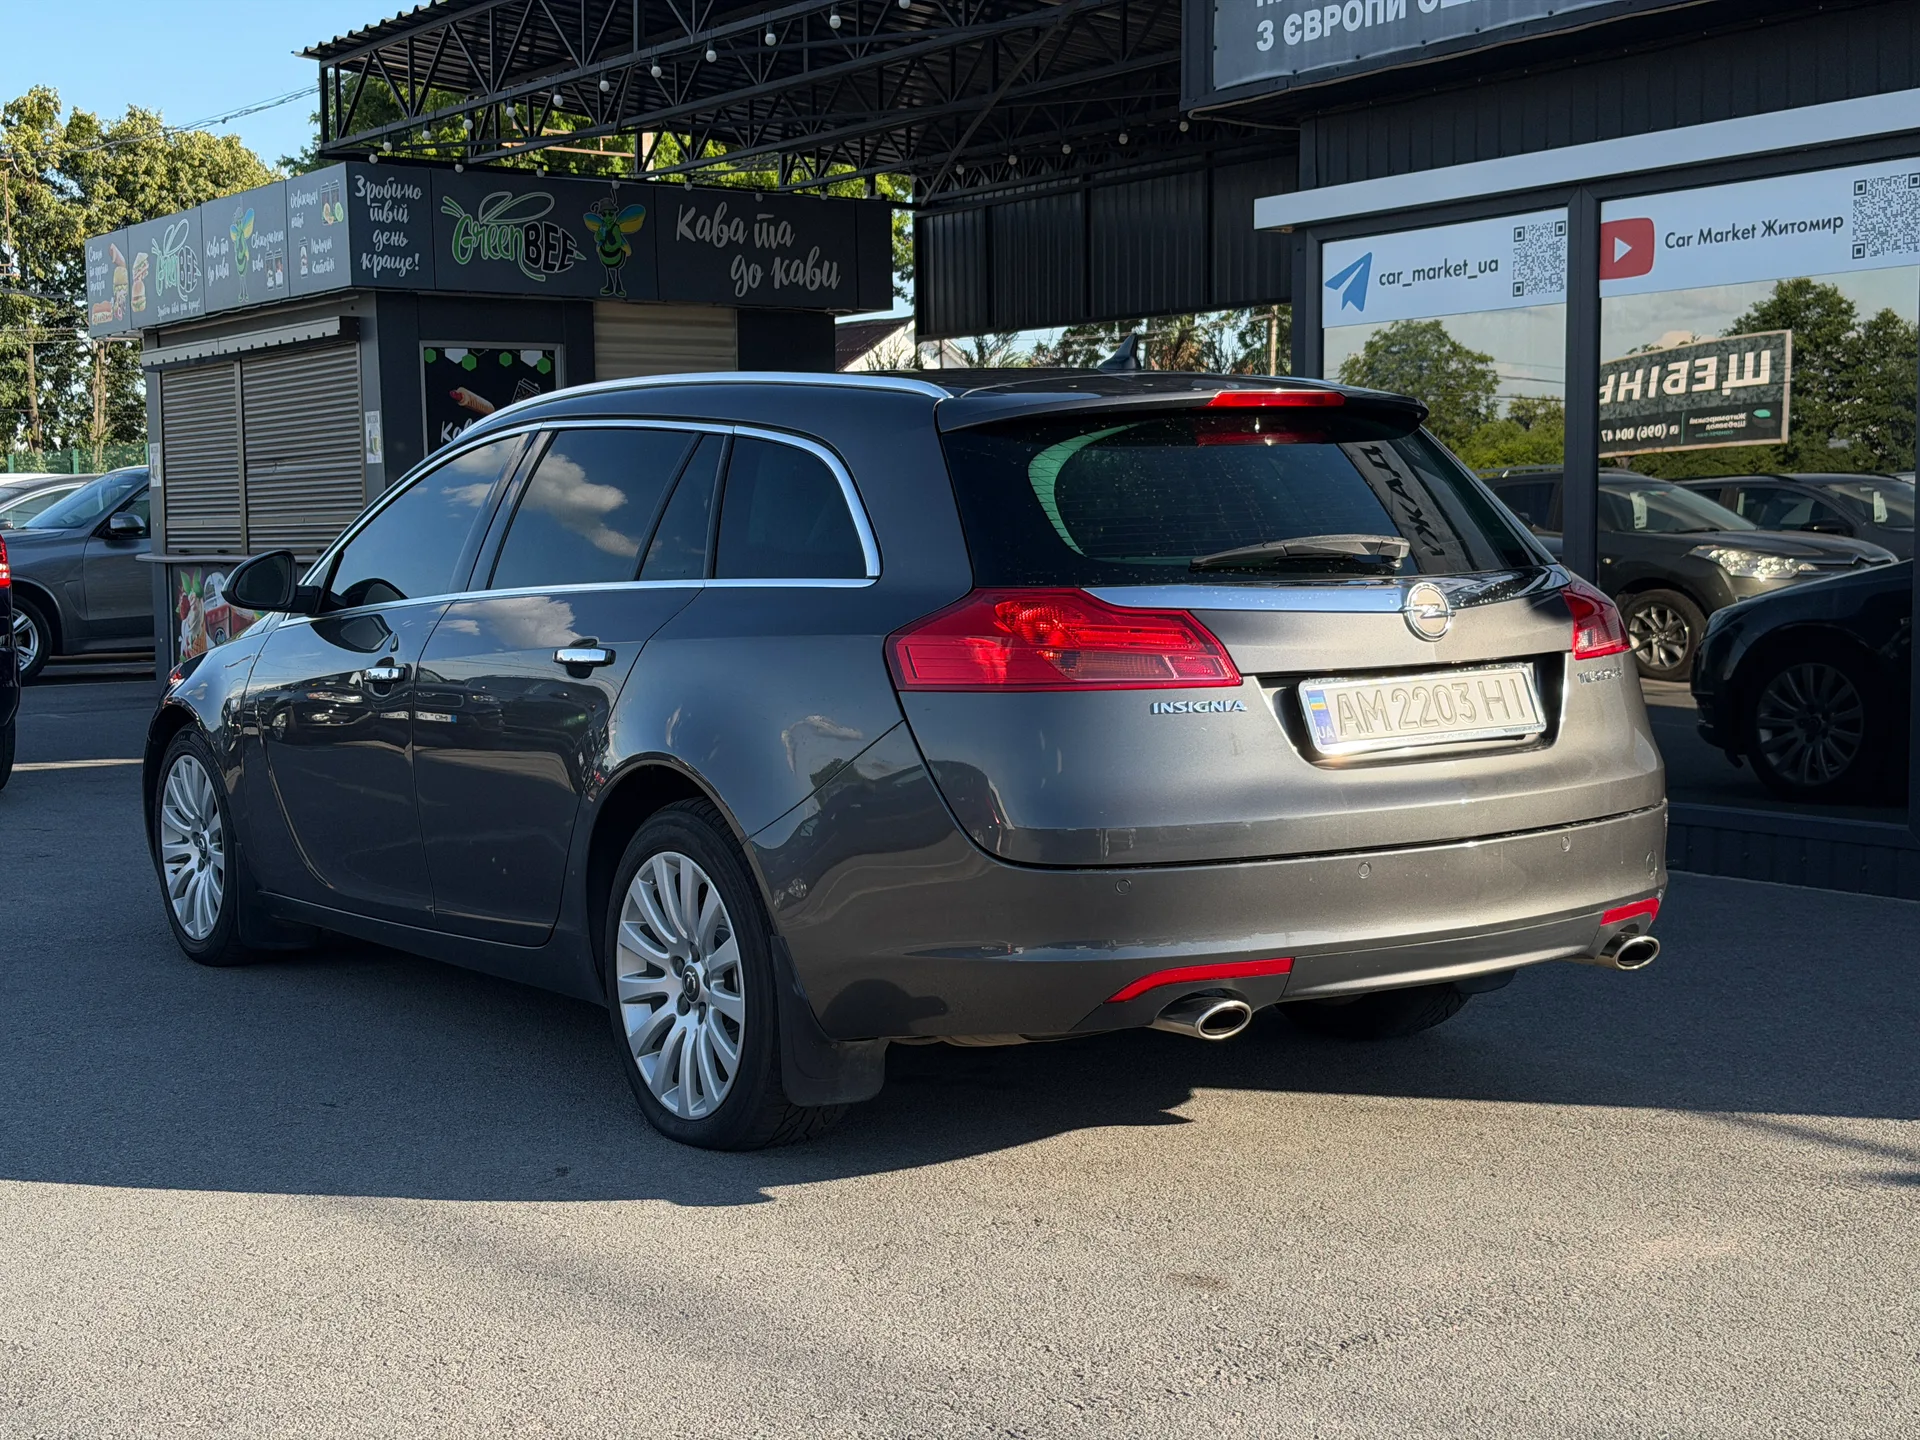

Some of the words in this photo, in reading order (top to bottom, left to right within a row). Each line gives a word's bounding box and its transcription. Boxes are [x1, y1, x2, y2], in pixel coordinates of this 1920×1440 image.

[1256, 19, 1275, 52] З
[1283, 0, 1407, 46] ЄВРОПИ
[354, 174, 423, 206] Зробимо
[369, 199, 410, 224] твій
[676, 201, 748, 248] Кава
[753, 213, 795, 250] та
[372, 229, 409, 252] день
[1664, 231, 1693, 249] Car
[1697, 222, 1757, 246] Market
[1760, 215, 1844, 238] Житомир
[360, 252, 420, 279] краще!
[730, 254, 764, 298] до
[770, 245, 841, 291] кави
[1379, 258, 1499, 287] car_market_ua
[1150, 699, 1248, 715] INSIGNIA
